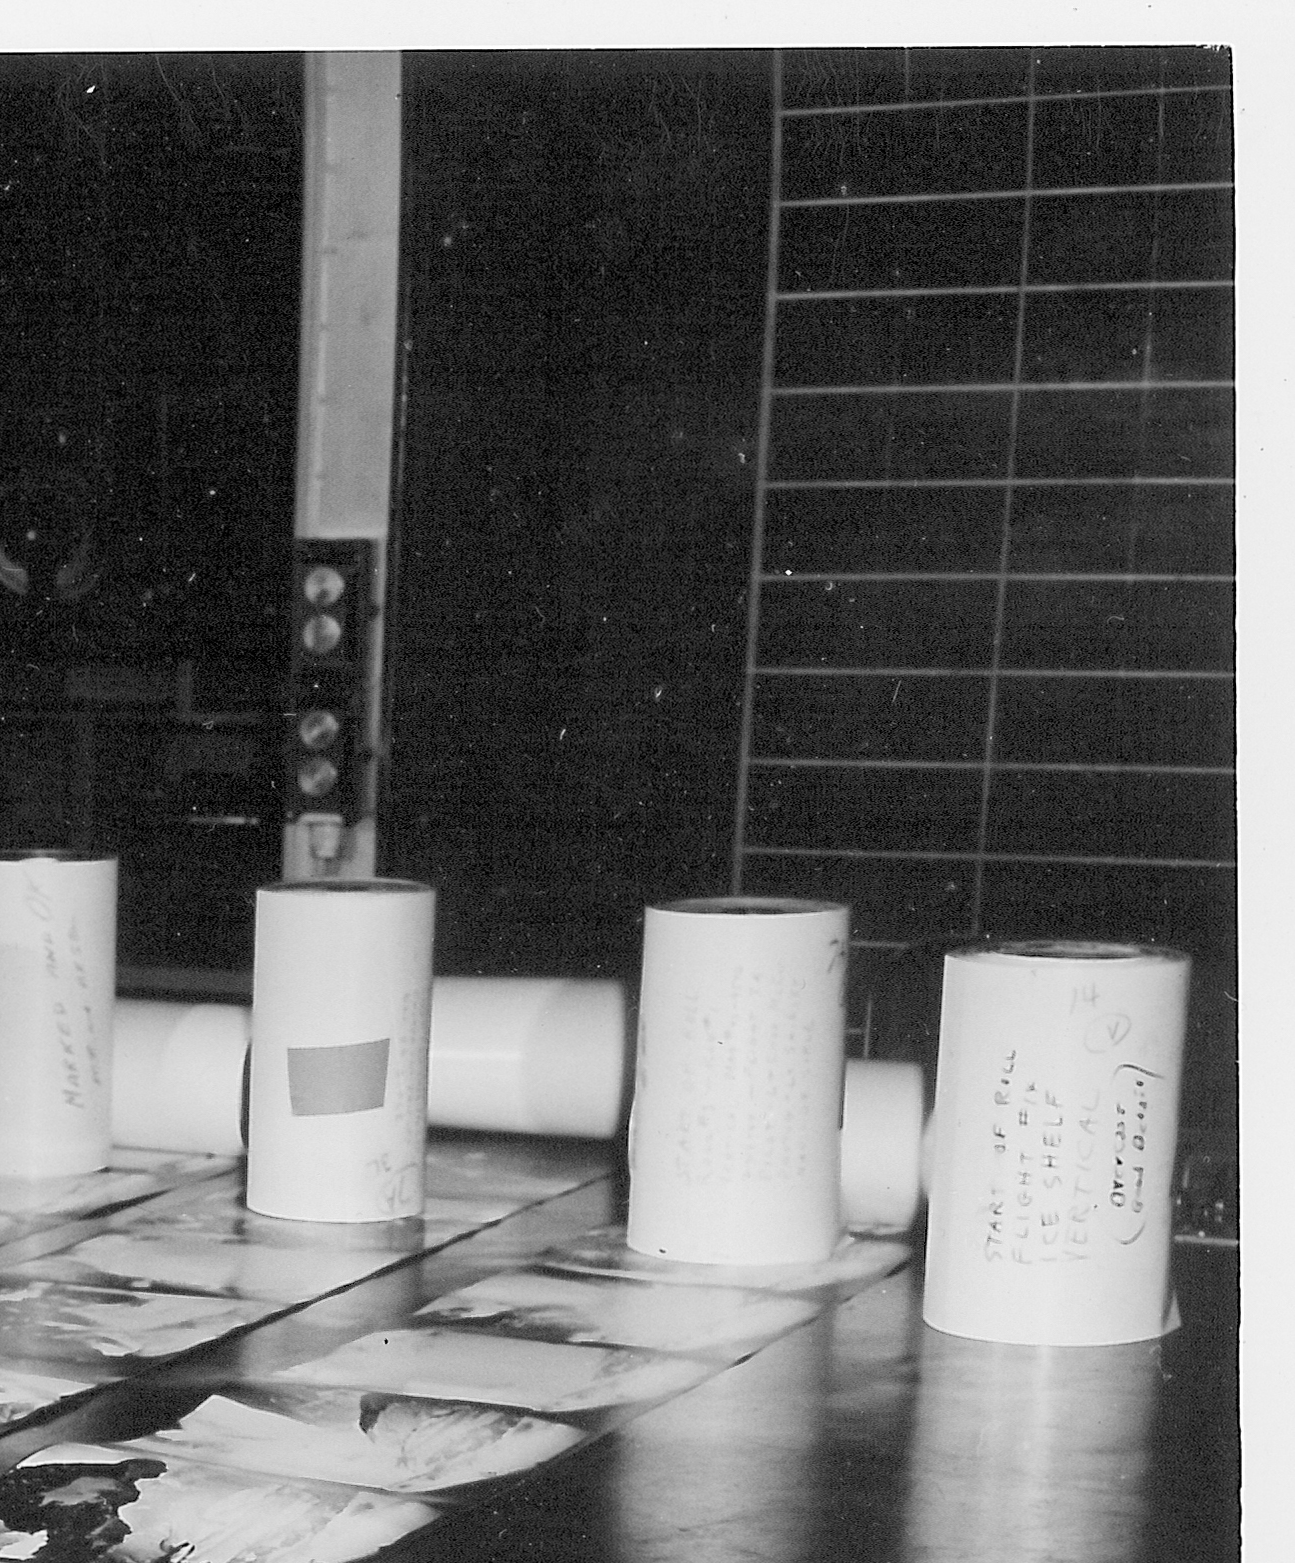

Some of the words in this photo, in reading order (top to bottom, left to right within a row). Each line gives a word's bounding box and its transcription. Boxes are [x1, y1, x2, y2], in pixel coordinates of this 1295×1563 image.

[1069, 982, 1101, 1014] 14
[52, 1001, 85, 1110] MARKED
[994, 1049, 1018, 1106] ROLL
[993, 1122, 1008, 1155] OF
[1040, 1087, 1063, 1190] SHELF
[1064, 1087, 1100, 1264] VERTICAL
[983, 1186, 1004, 1263] START
[1011, 1150, 1035, 1266] FLIGHT
[1040, 1210, 1060, 1264] ICE
